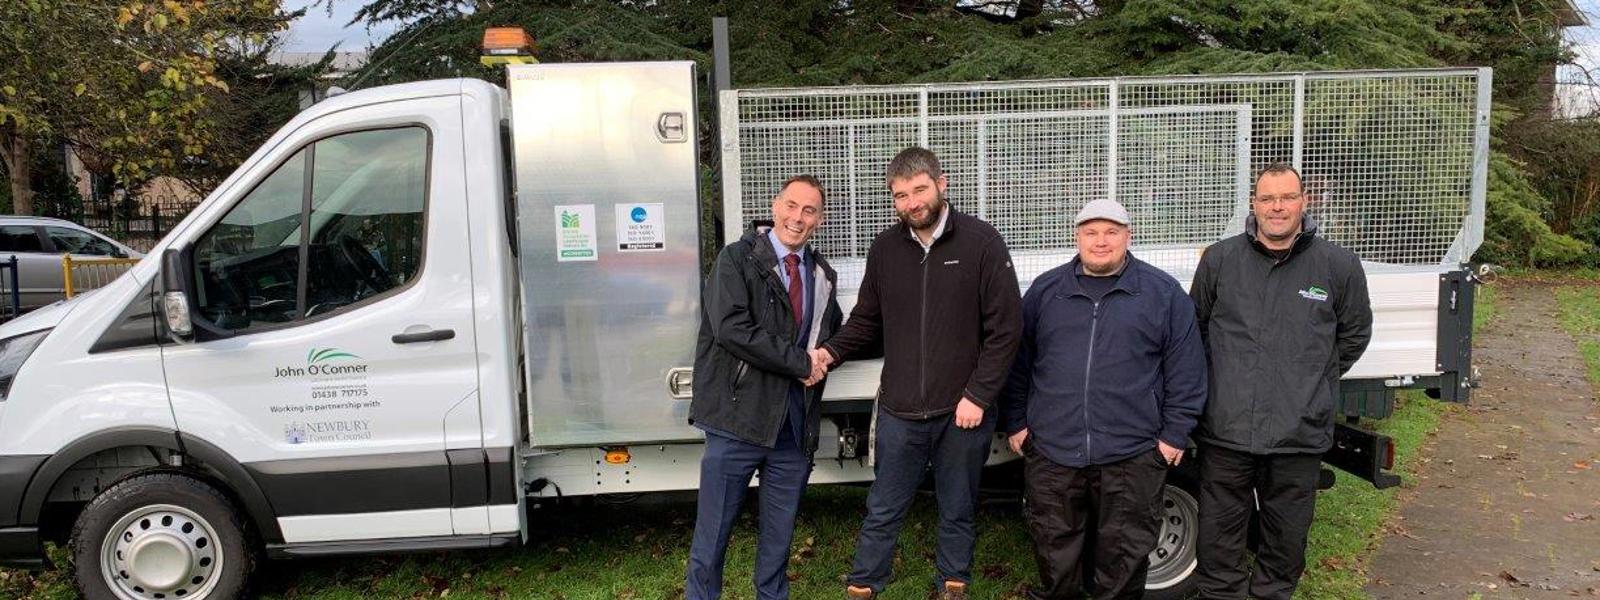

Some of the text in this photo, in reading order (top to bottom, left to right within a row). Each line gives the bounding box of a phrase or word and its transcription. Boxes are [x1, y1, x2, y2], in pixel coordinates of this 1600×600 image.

[274, 364, 368, 378] John O'Conner
[312, 388, 368, 399] 01438 717175
[270, 400, 381, 413] Working in partnership with
[307, 420, 370, 433] NEWBURY
[308, 431, 371, 442] Town Council
